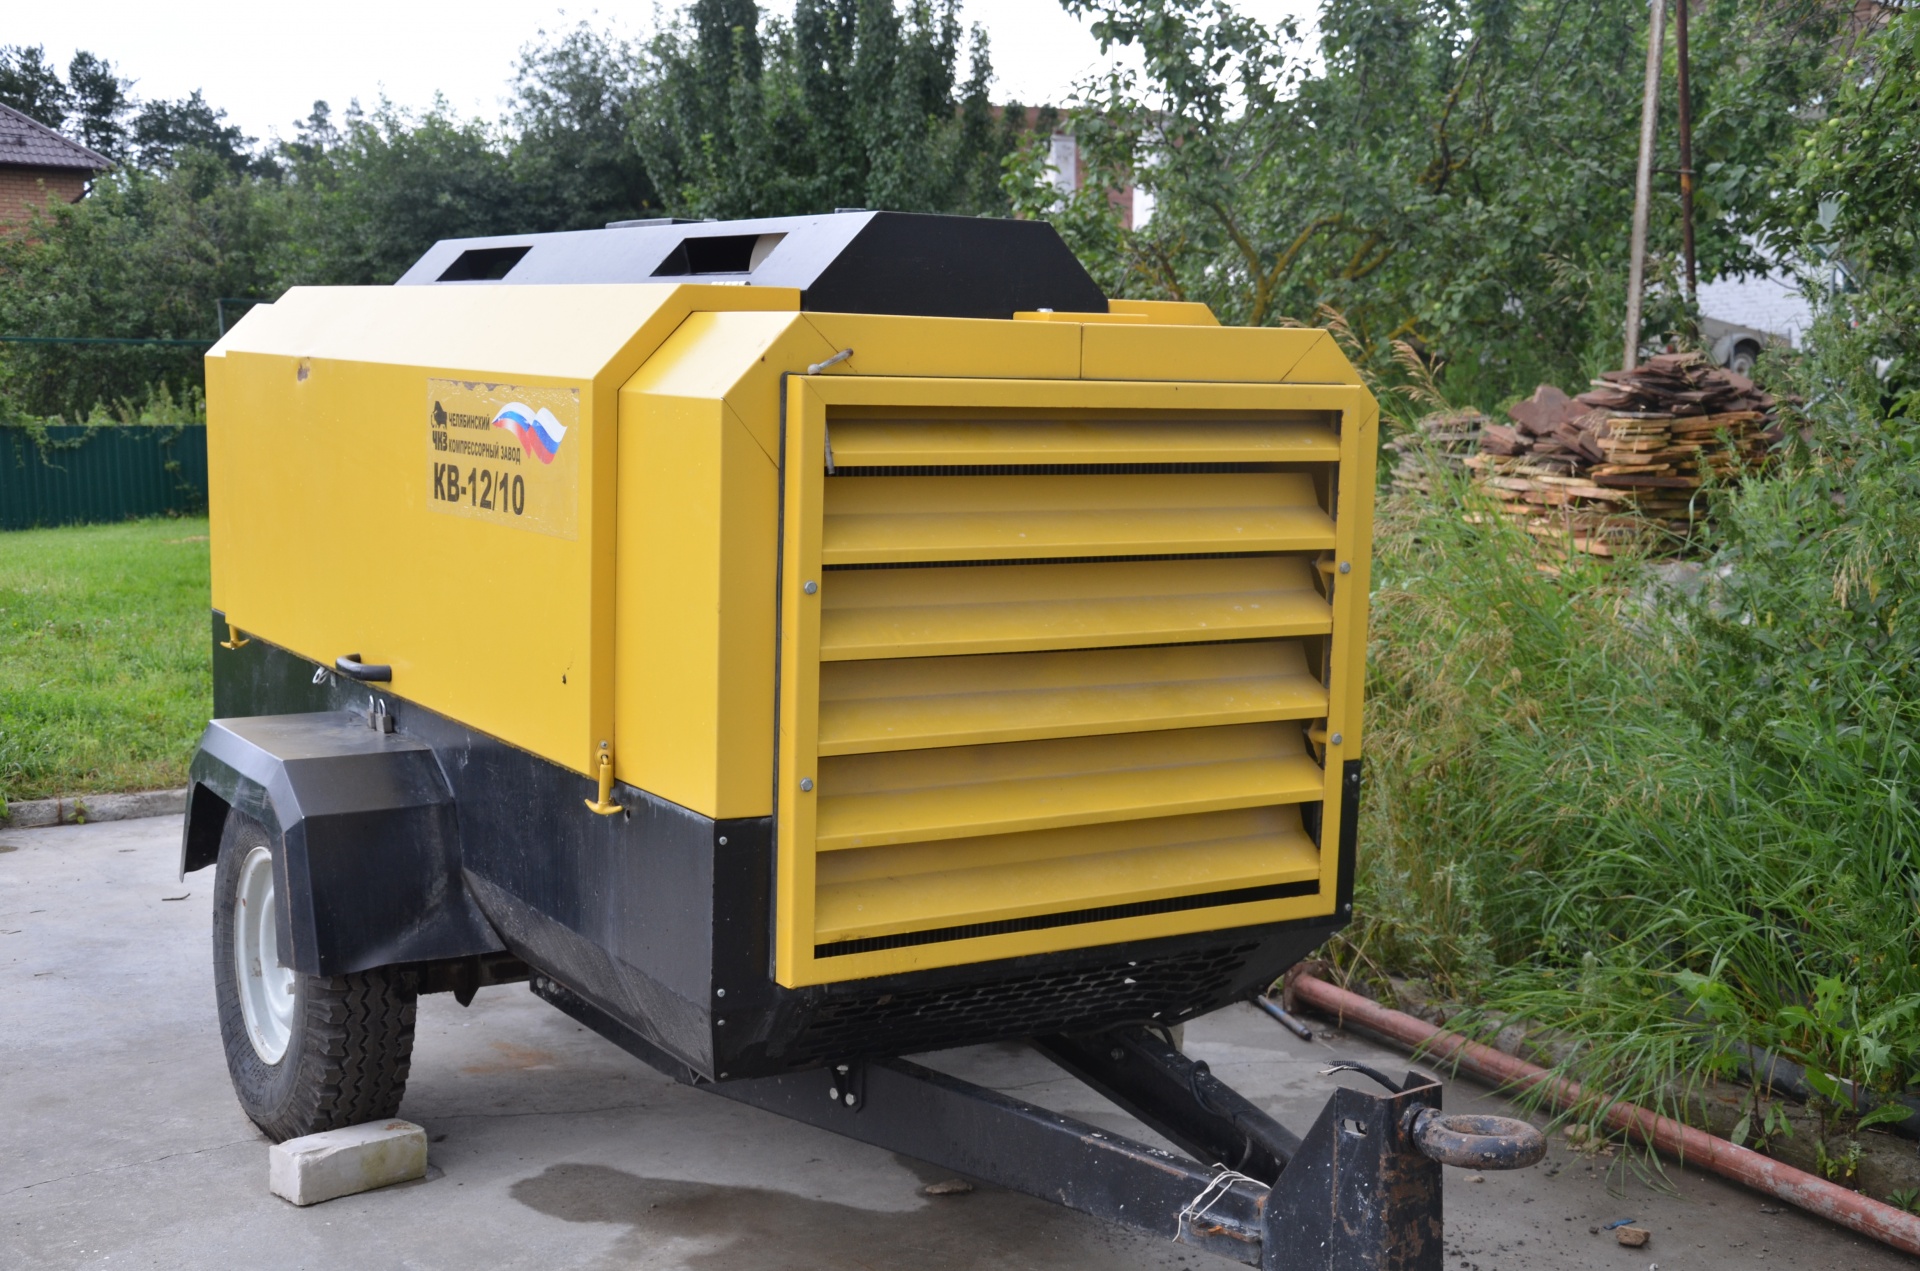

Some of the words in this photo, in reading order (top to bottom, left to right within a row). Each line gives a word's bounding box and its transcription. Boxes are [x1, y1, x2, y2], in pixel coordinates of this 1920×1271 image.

[448, 413, 490, 431] ЧЕЛЯБИНСКИЙ
[432, 430, 447, 451] ЧКЗ
[448, 439, 499, 459] КОМПРЕССОРНЫЙ
[500, 447, 521, 465] ЗАВОД
[433, 462, 525, 515] КВ-12/10
